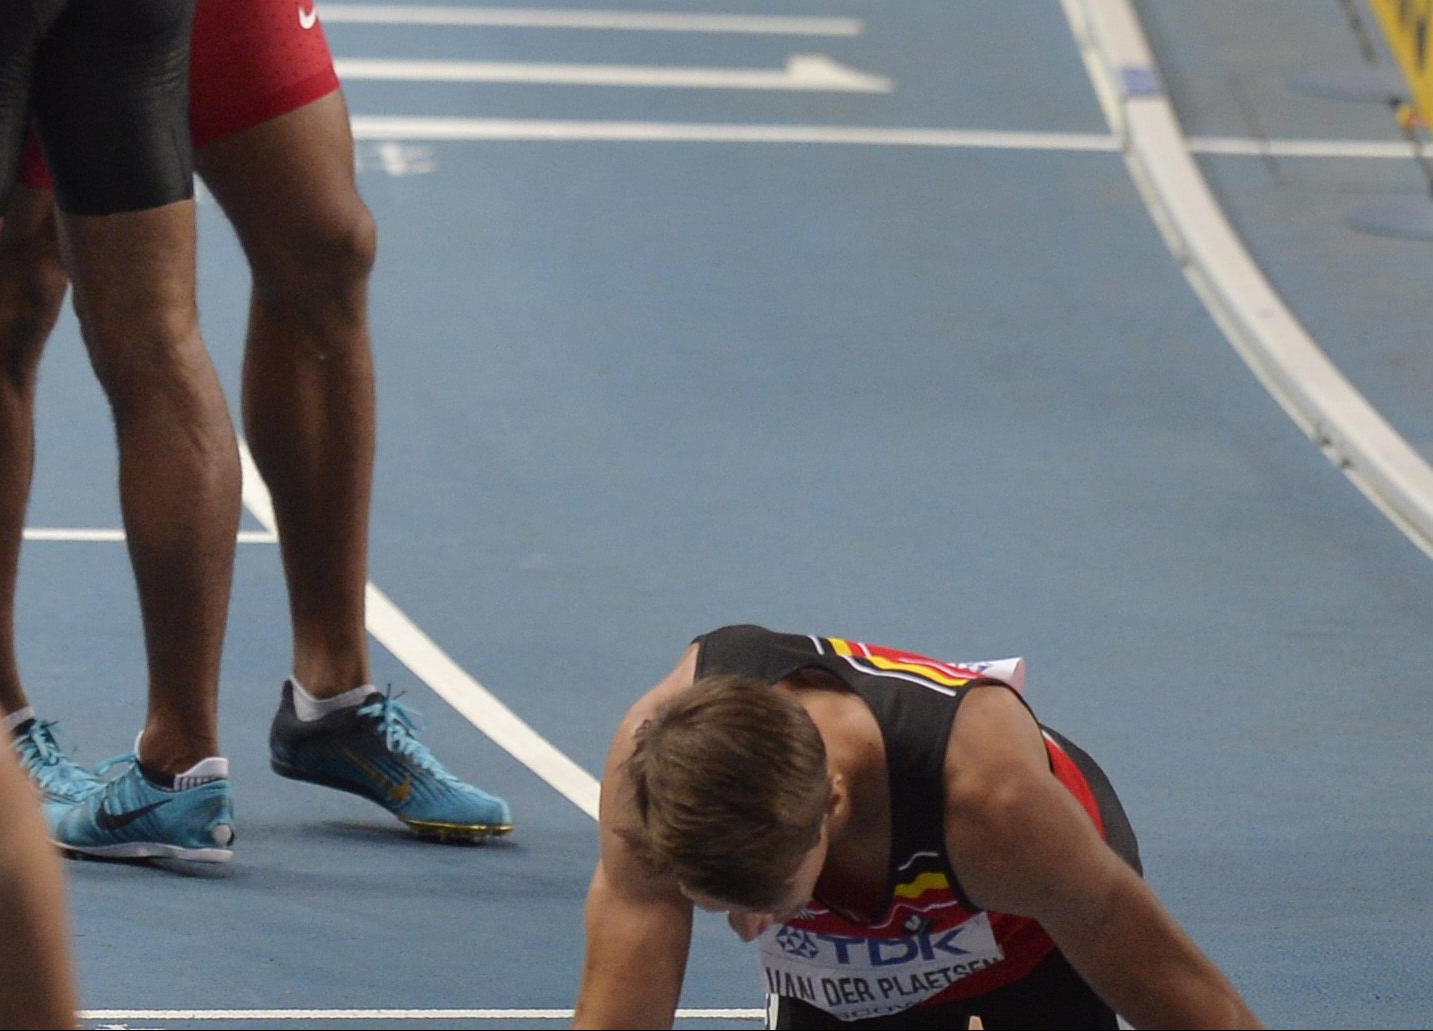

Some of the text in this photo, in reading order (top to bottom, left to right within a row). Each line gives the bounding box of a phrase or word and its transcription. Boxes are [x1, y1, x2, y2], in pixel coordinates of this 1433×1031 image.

[817, 926, 971, 967] TDK
[766, 967, 816, 1001] VAN
[821, 977, 875, 1008] DER
